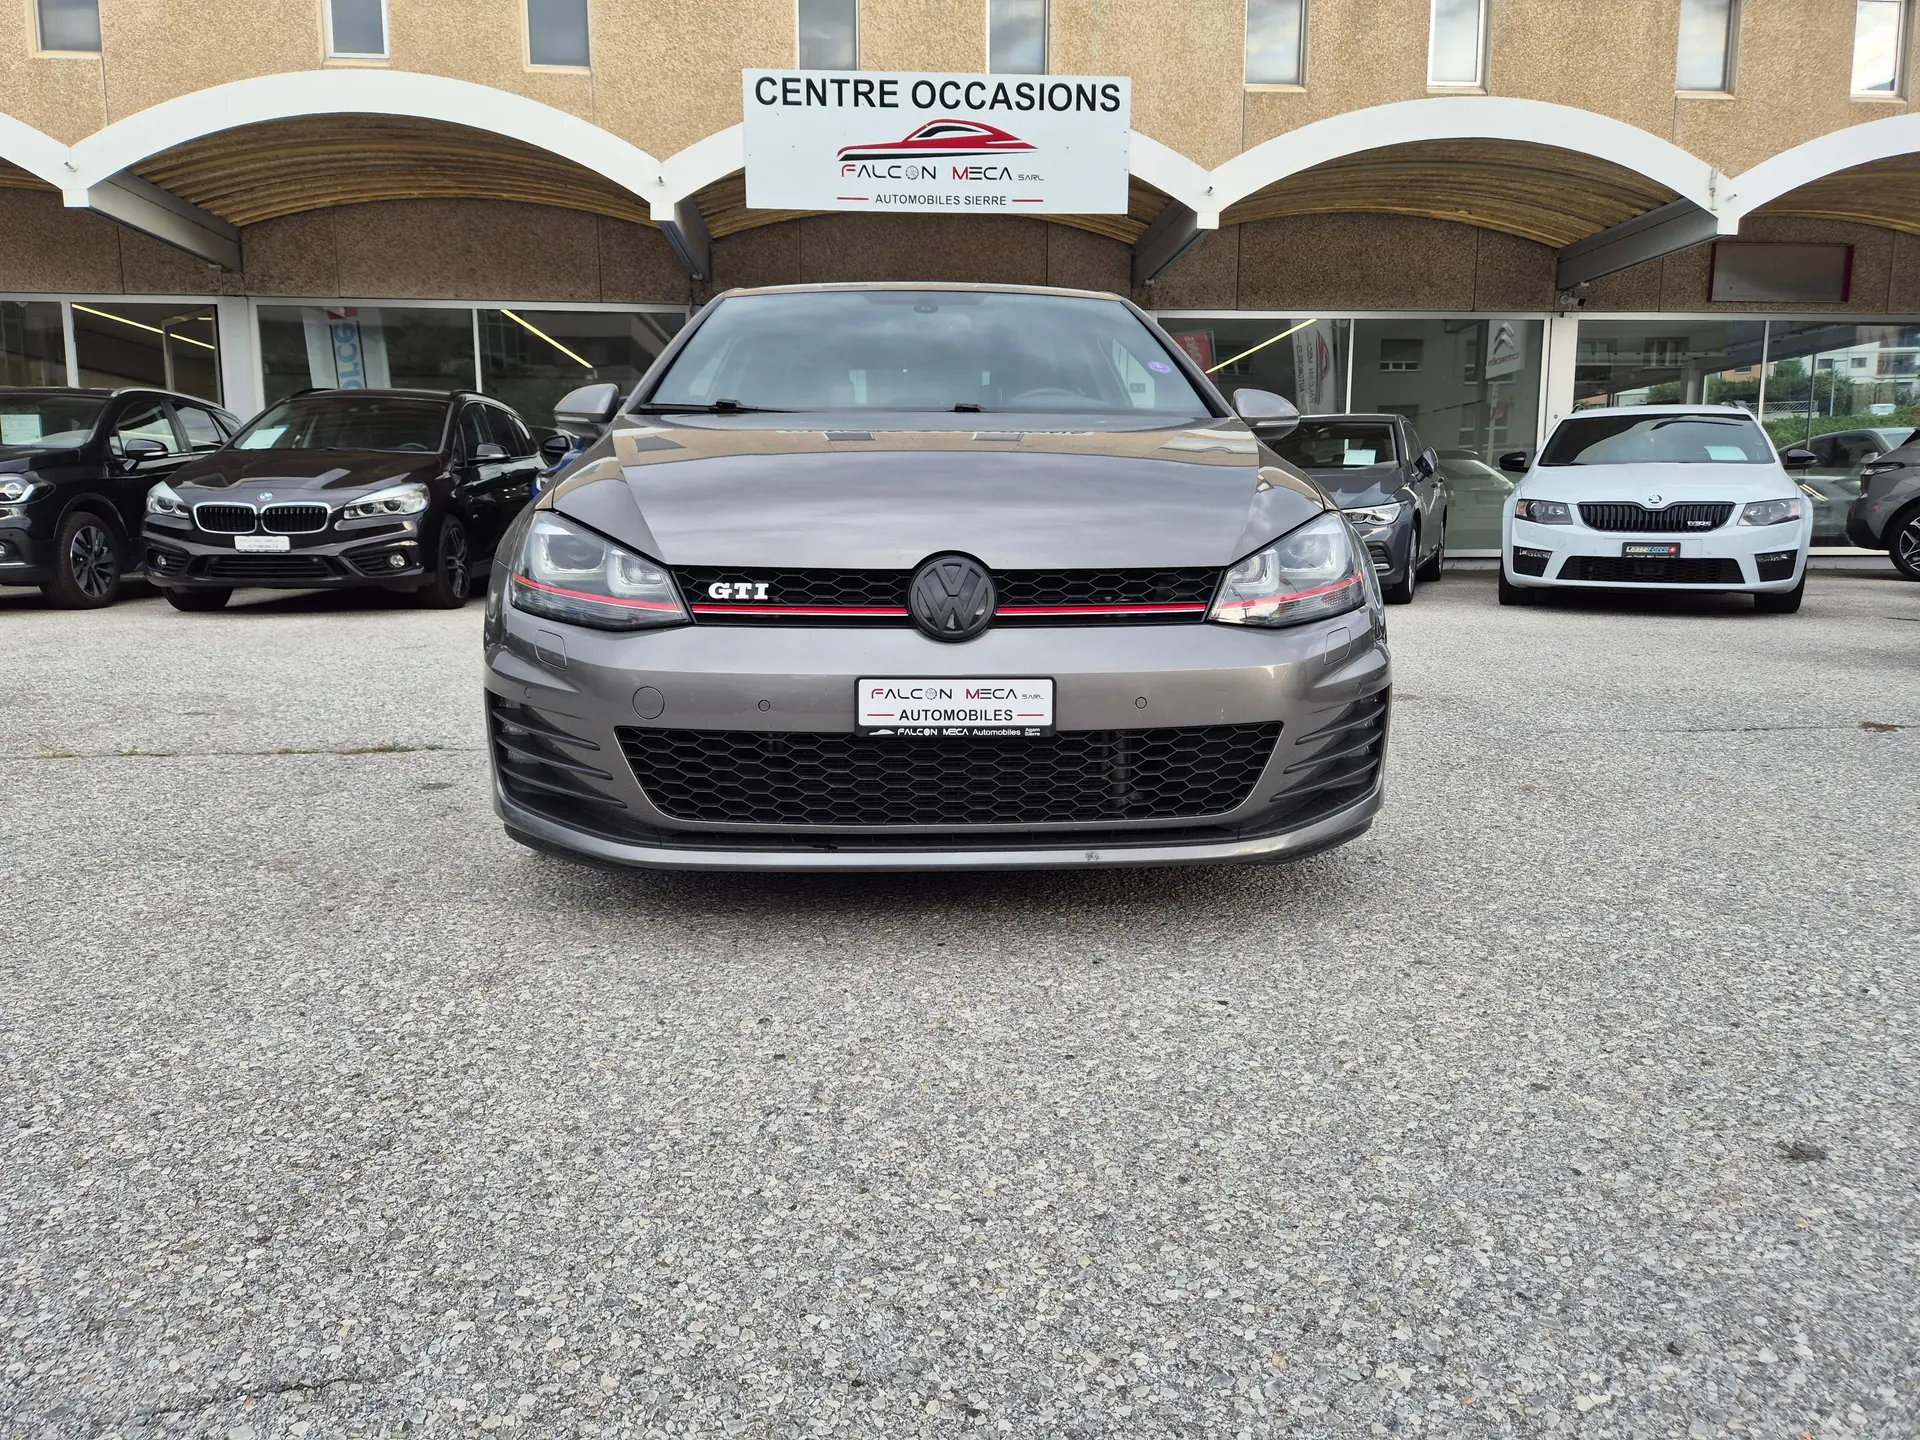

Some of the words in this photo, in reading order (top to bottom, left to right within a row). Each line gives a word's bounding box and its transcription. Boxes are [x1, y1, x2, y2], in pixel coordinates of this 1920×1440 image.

[755, 76, 899, 108] CENTRE
[911, 79, 1121, 113] OCCASIONS
[841, 164, 937, 180] FALCON
[952, 166, 1012, 181] MECA
[875, 193, 960, 205] AUTOMOBILES
[964, 195, 1007, 206] SIERRE
[708, 582, 769, 600] GTI
[871, 687, 952, 700] FALCON
[965, 688, 1018, 700] MECA
[899, 709, 1013, 721] AUTOMOBILES
[897, 728, 938, 736] FALCON
[942, 728, 969, 736] MECA
[972, 728, 1021, 736] Automobiles
